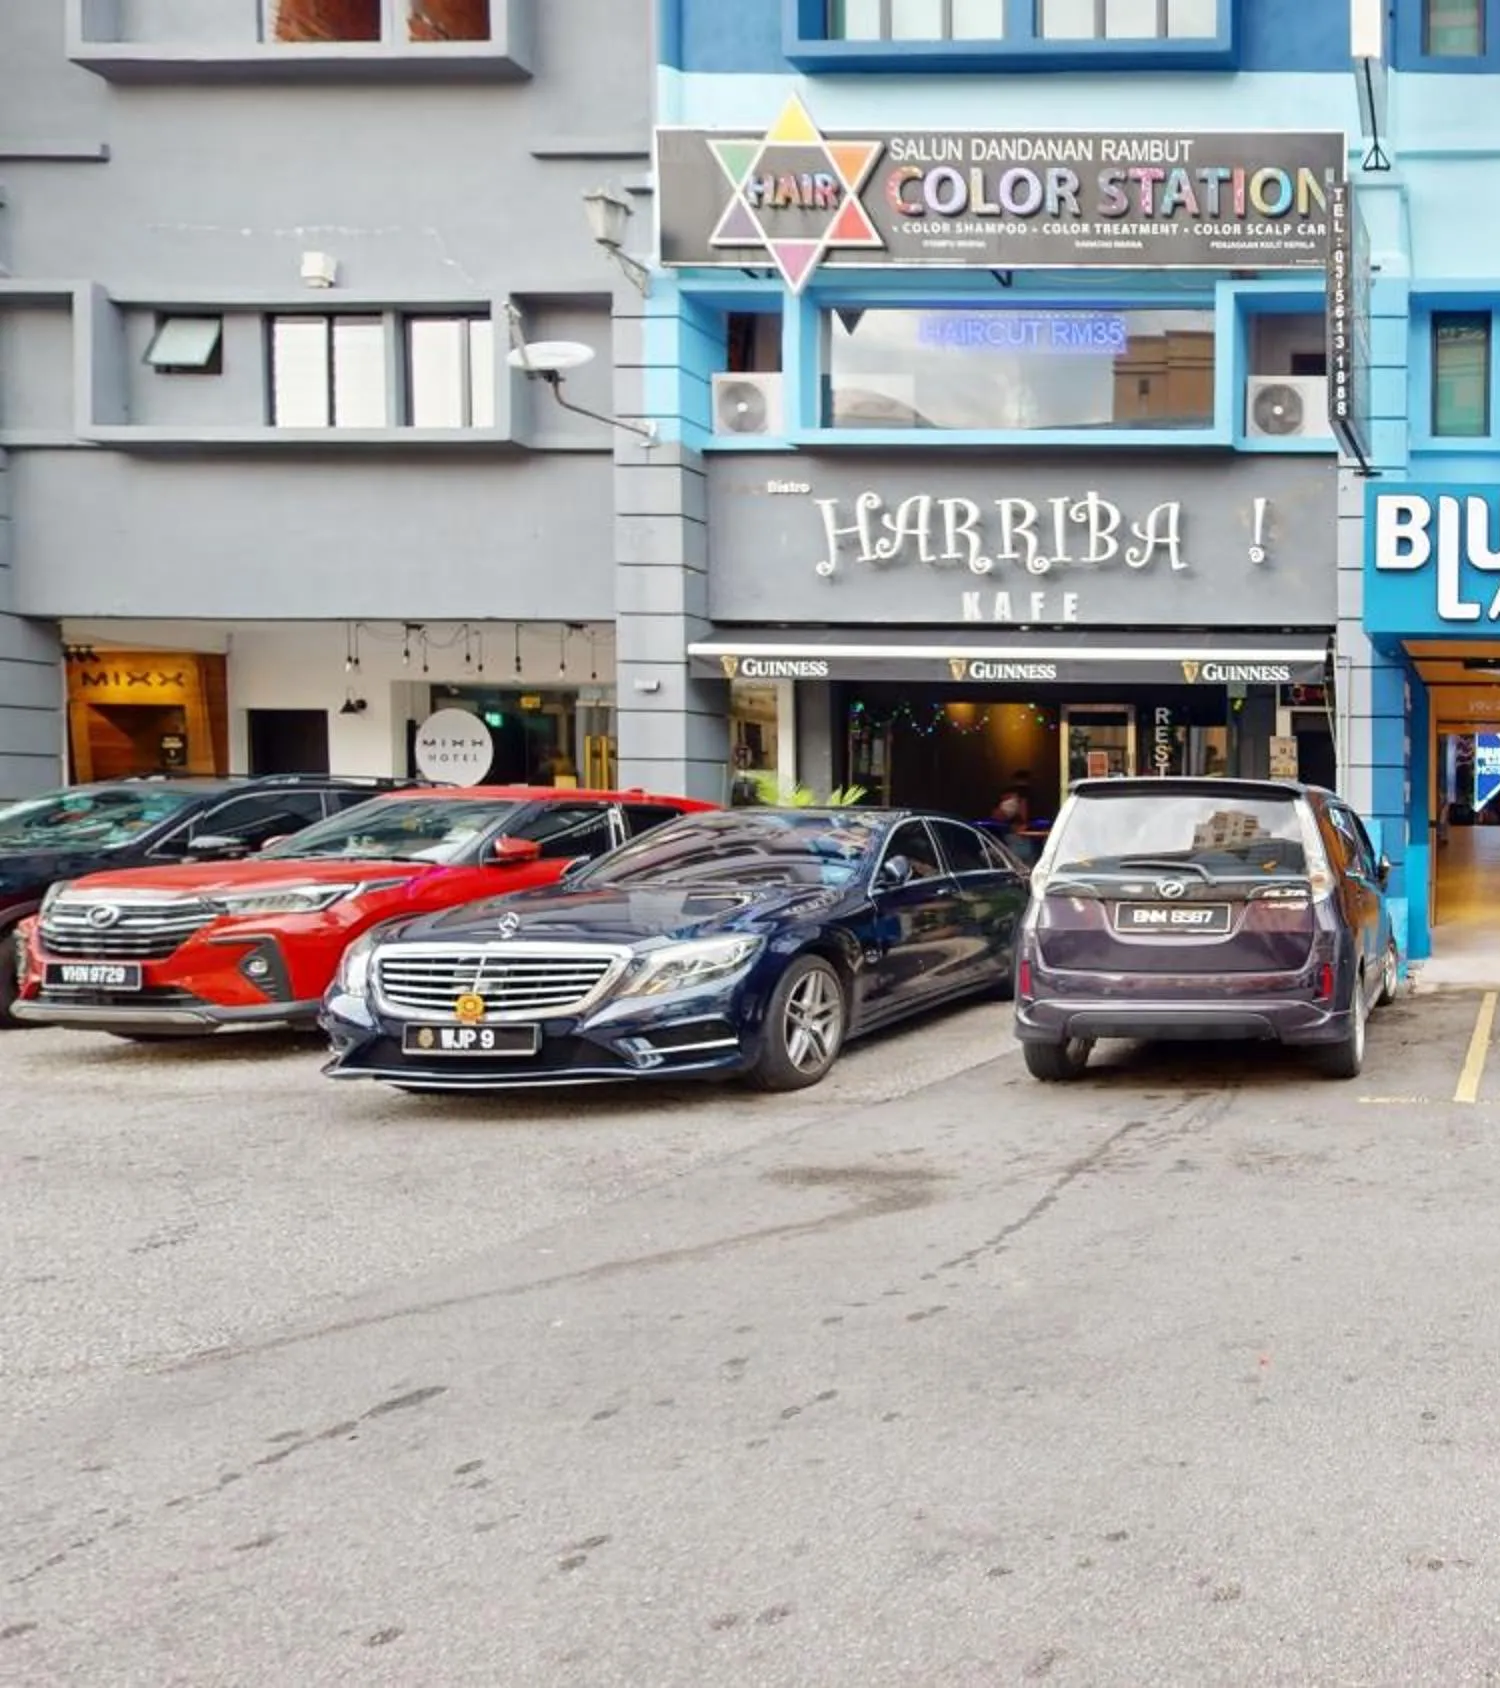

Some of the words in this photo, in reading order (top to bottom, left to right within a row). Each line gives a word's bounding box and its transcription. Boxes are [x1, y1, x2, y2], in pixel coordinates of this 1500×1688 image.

[890, 139, 964, 163] SALUN
[970, 139, 1094, 163] DANDANAN
[1101, 139, 1194, 163] RAMBUT
[746, 172, 839, 210] HAIR
[885, 166, 1081, 219] COLOR
[1099, 166, 1329, 219] STATION
[903, 223, 951, 235] COLOR
[955, 223, 1027, 235] SHAMPOO
[1043, 223, 1090, 235] COLOR
[1094, 223, 1179, 235] TREATMENT
[1194, 223, 1242, 235] COLOR
[1246, 223, 1291, 235] SCALP
[1297, 223, 1327, 235] CAR
[920, 320, 1042, 345] HAIRCUT
[1051, 320, 1124, 345] RM35
[814, 490, 1190, 577] HARRIBA
[962, 591, 1080, 622] KAFE
[740, 657, 829, 677] GUINNESS
[969, 659, 1057, 680] GUINNESS
[1201, 661, 1290, 682] GUINNESS
[82, 669, 186, 688] MIXX
[428, 753, 479, 763] HOTEL
[61, 965, 89, 983] VHN
[90, 965, 126, 984] 9729
[441, 1029, 477, 1051] WJP
[480, 1029, 495, 1050] 9
